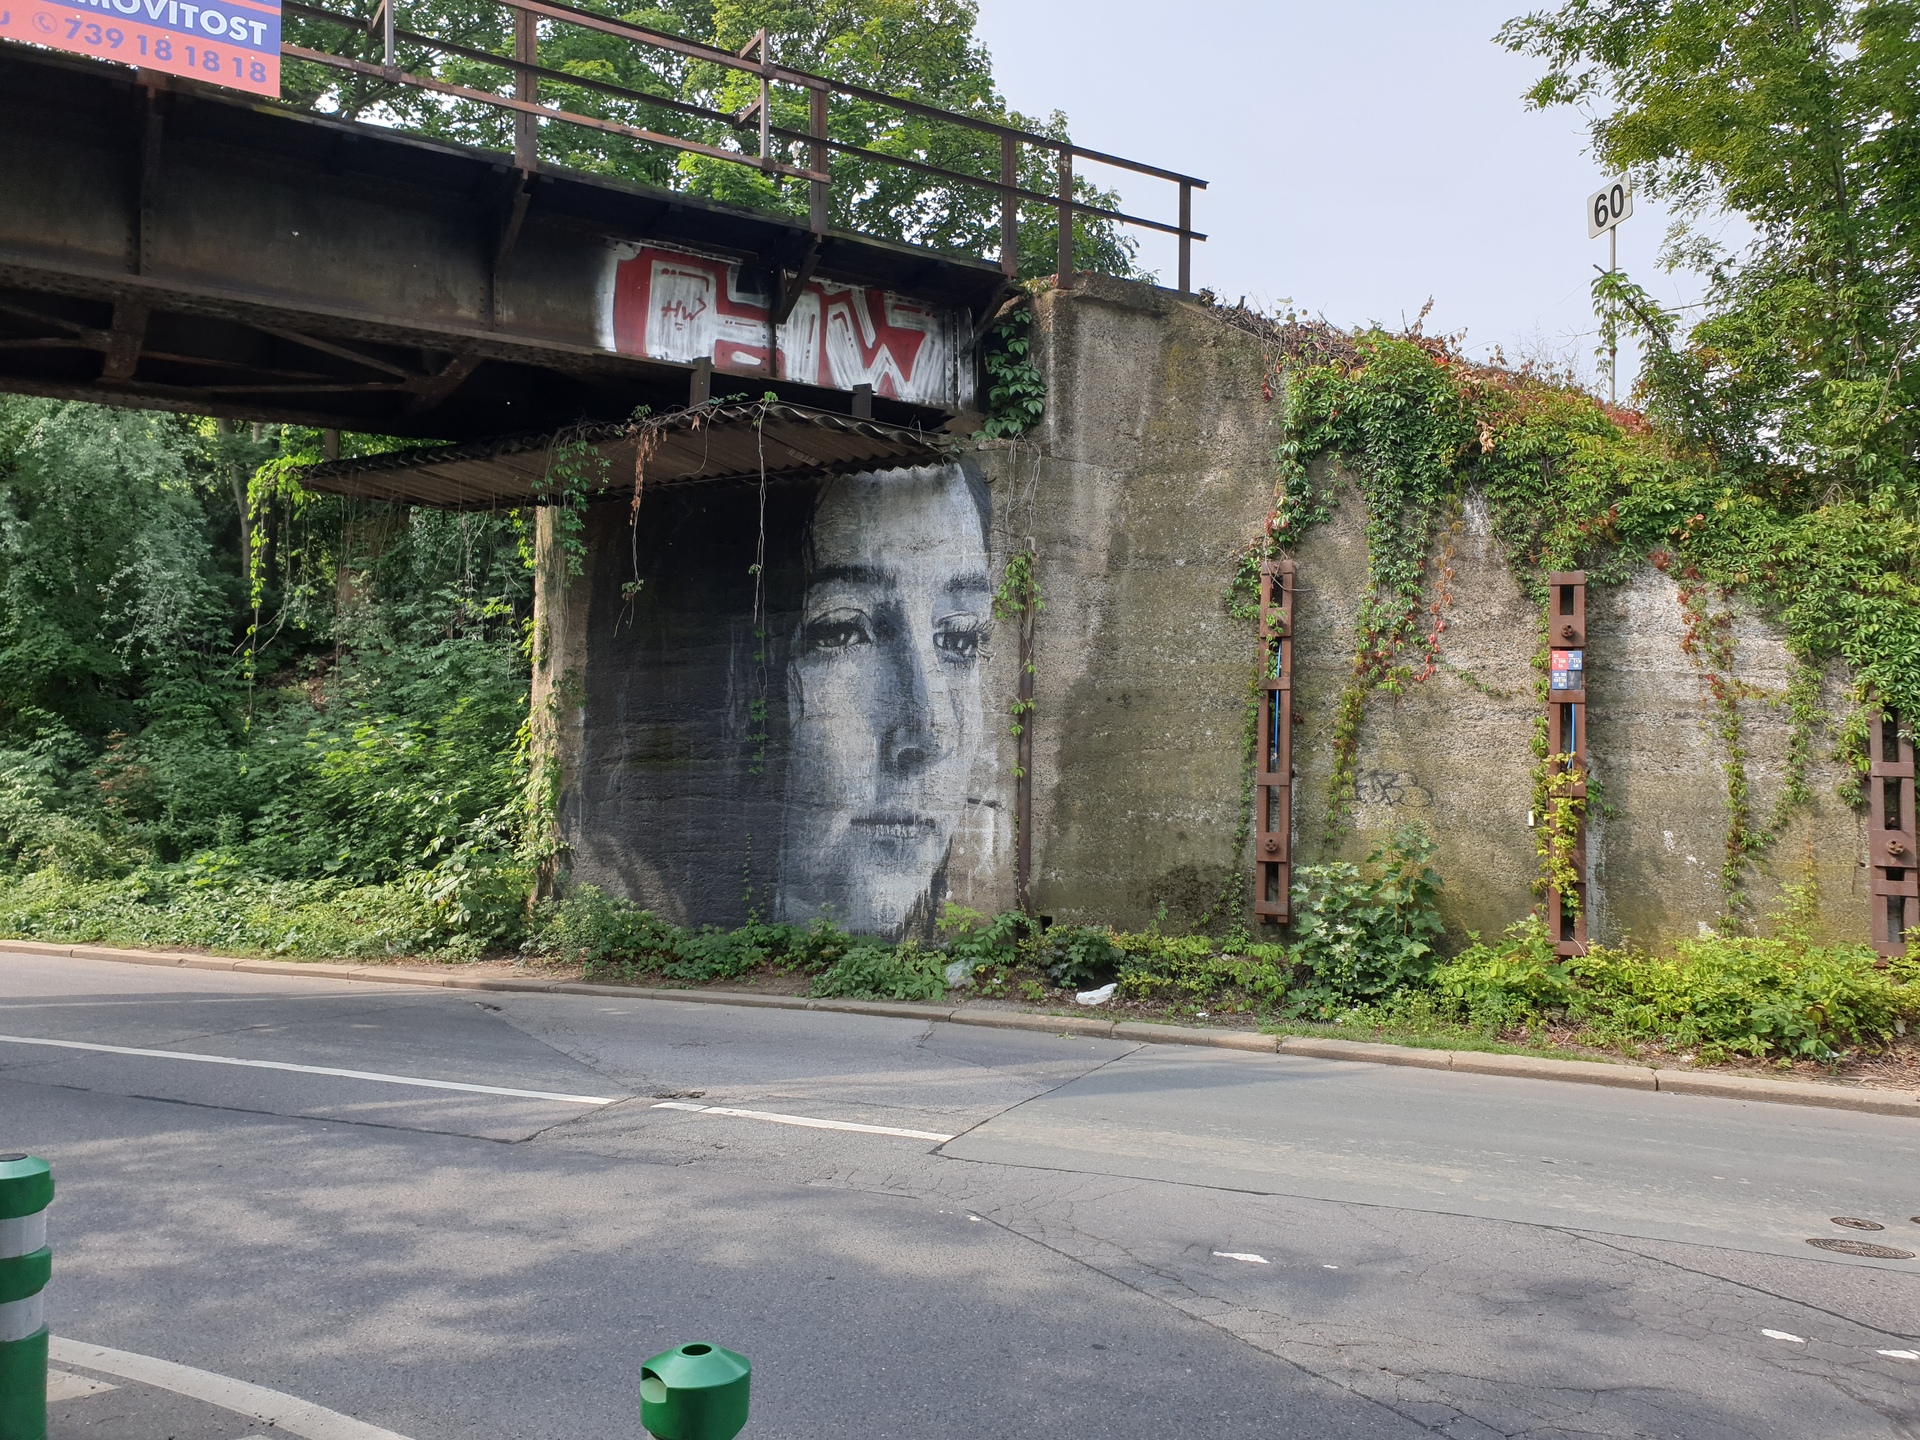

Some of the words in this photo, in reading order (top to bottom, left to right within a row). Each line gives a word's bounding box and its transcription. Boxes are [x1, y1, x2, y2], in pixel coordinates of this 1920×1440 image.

[64, 18, 124, 49] 739
[137, 34, 173, 61] 18
[185, 45, 220, 72] 18
[232, 57, 266, 83] 18
[1594, 184, 1624, 228] 60
